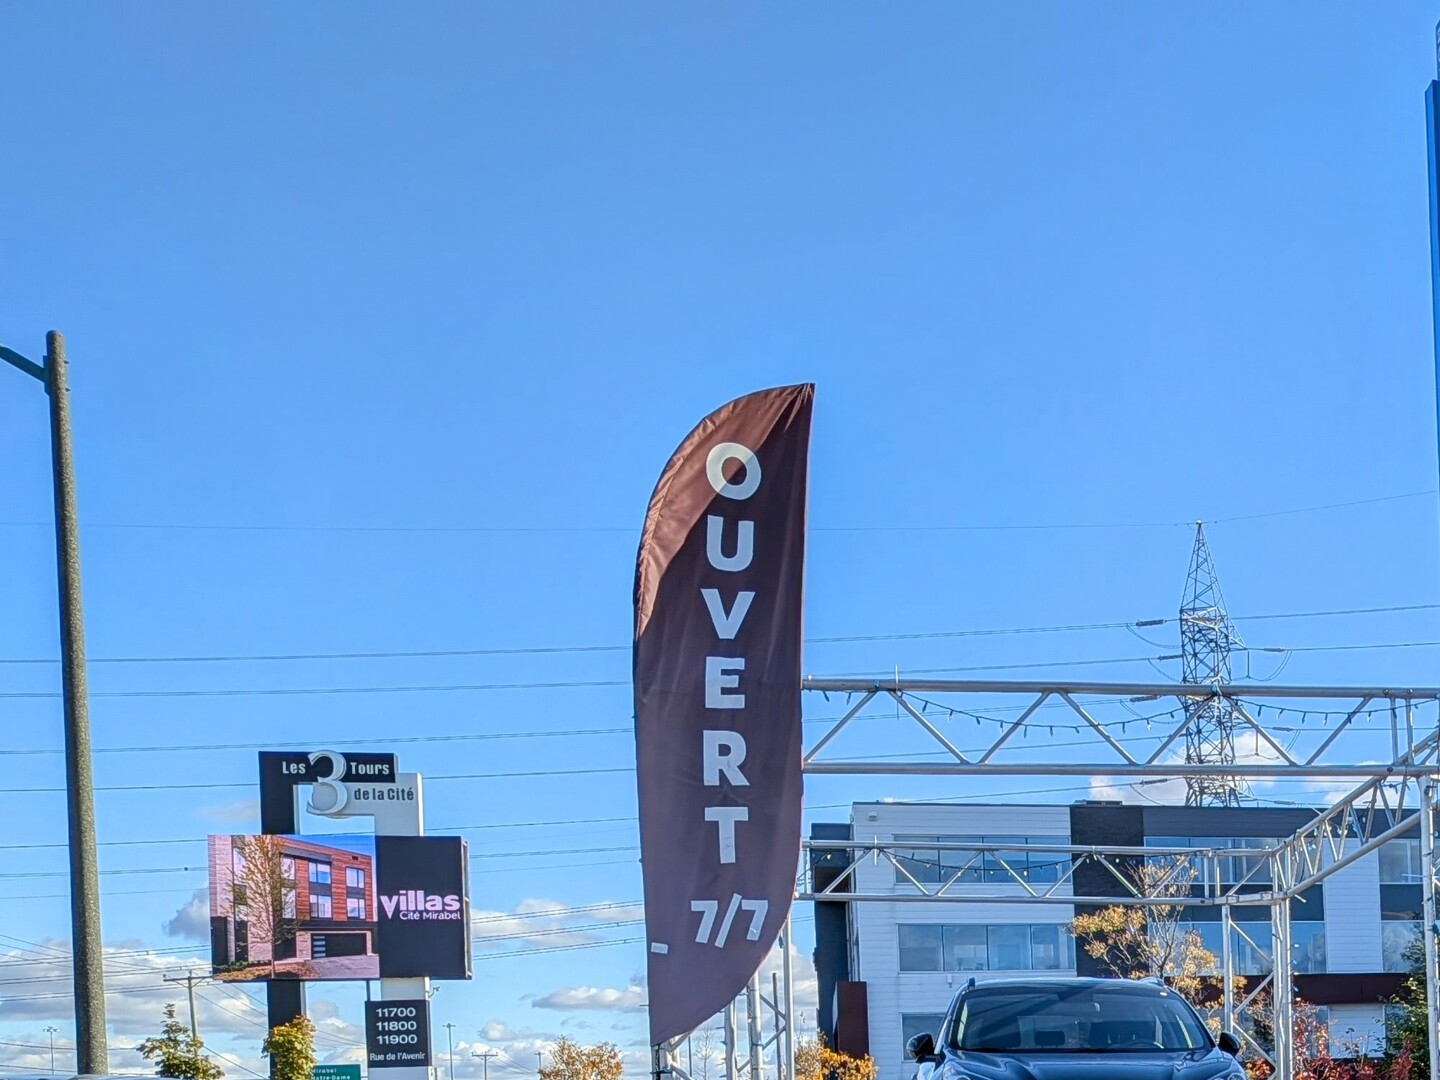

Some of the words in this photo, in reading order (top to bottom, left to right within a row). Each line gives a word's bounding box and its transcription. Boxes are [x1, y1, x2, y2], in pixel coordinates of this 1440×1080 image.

[700, 442, 762, 864] OUVERT
[282, 761, 306, 774] Les
[305, 750, 348, 816] 3
[350, 762, 390, 775] Tours
[354, 788, 370, 801] de
[372, 788, 385, 801] la
[387, 787, 415, 801] Cité
[380, 890, 461, 919] villas
[400, 911, 420, 920] Cité
[422, 911, 461, 920] Mirabel
[690, 893, 768, 948] 7/7
[376, 1007, 416, 1017] 11700
[376, 1021, 417, 1031] 11800
[376, 1034, 418, 1045] 11900
[370, 1053, 385, 1061] Rue
[397, 1052, 426, 1060] l'Avenir
